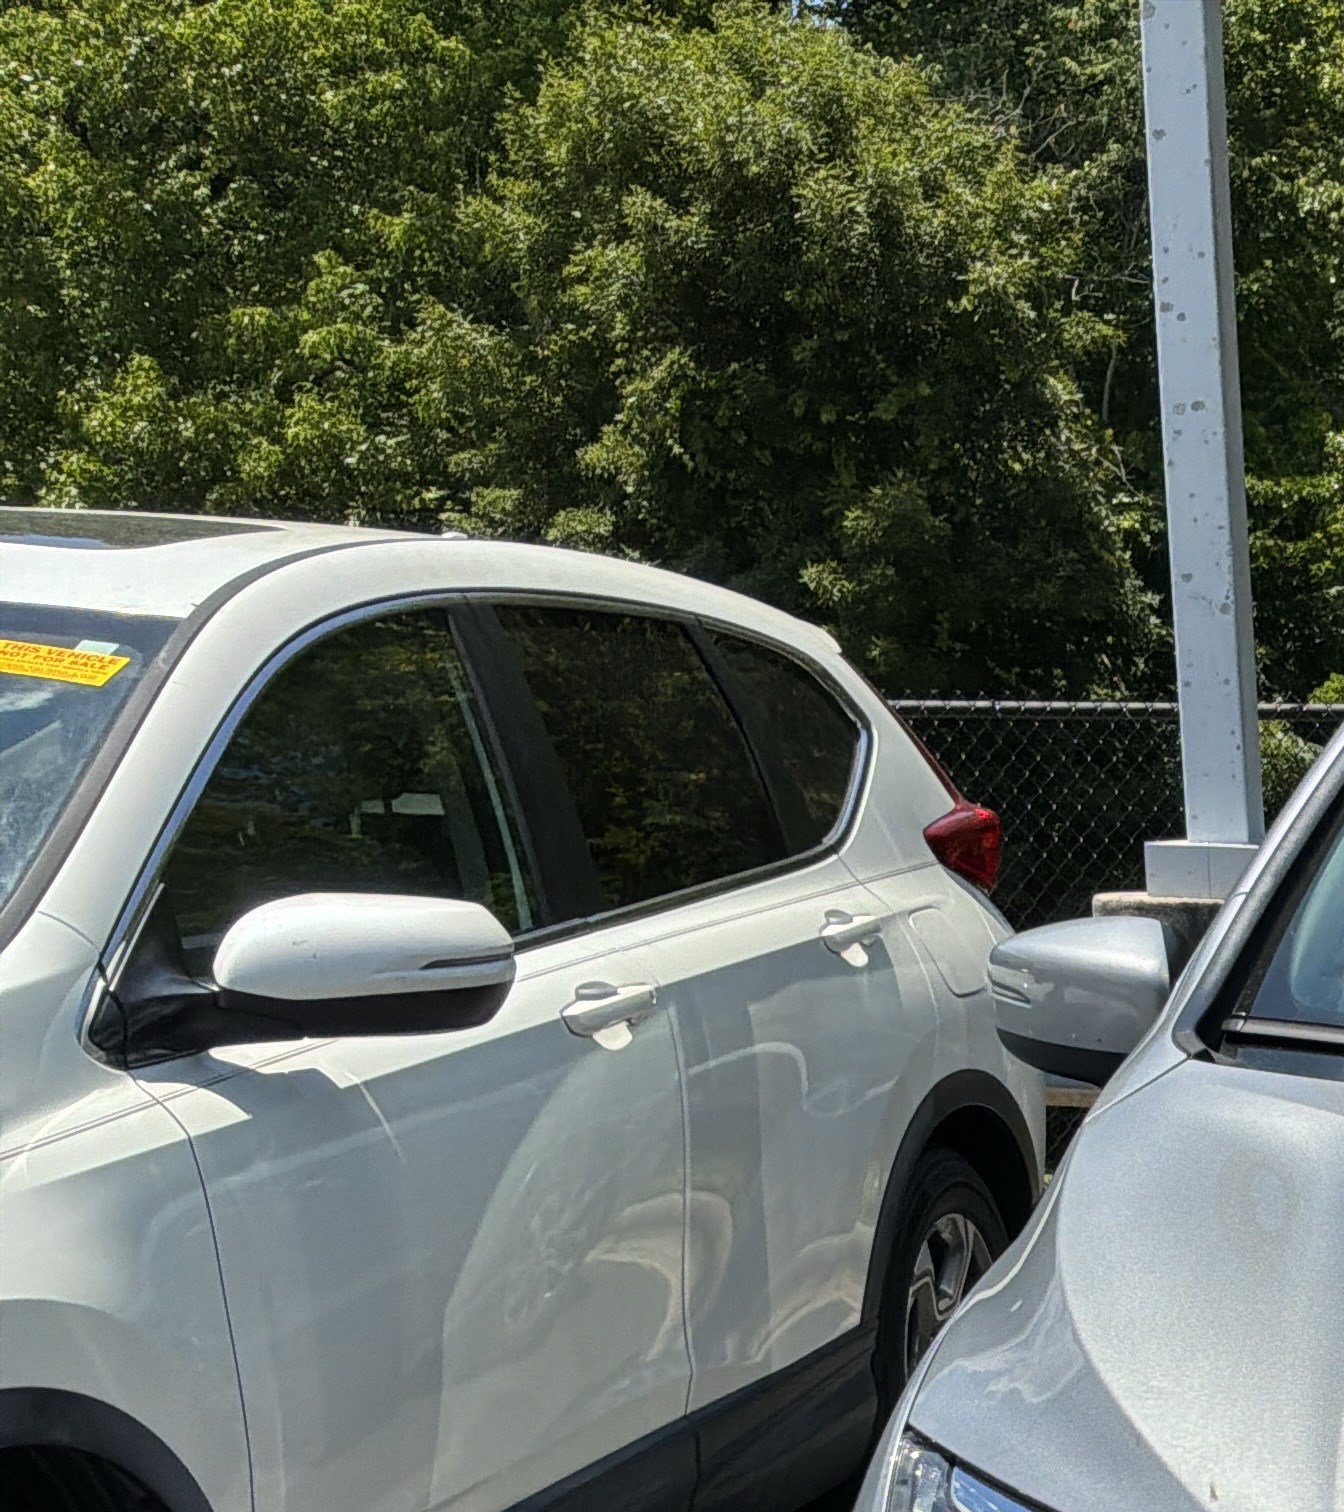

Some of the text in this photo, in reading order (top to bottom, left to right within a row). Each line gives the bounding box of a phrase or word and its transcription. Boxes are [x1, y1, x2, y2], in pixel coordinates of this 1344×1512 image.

[0, 650, 29, 660] NOT
[33, 654, 65, 664] FOR
[69, 659, 111, 671] SALE
[3, 642, 40, 653] THIS
[49, 647, 121, 666] VEHICLE
